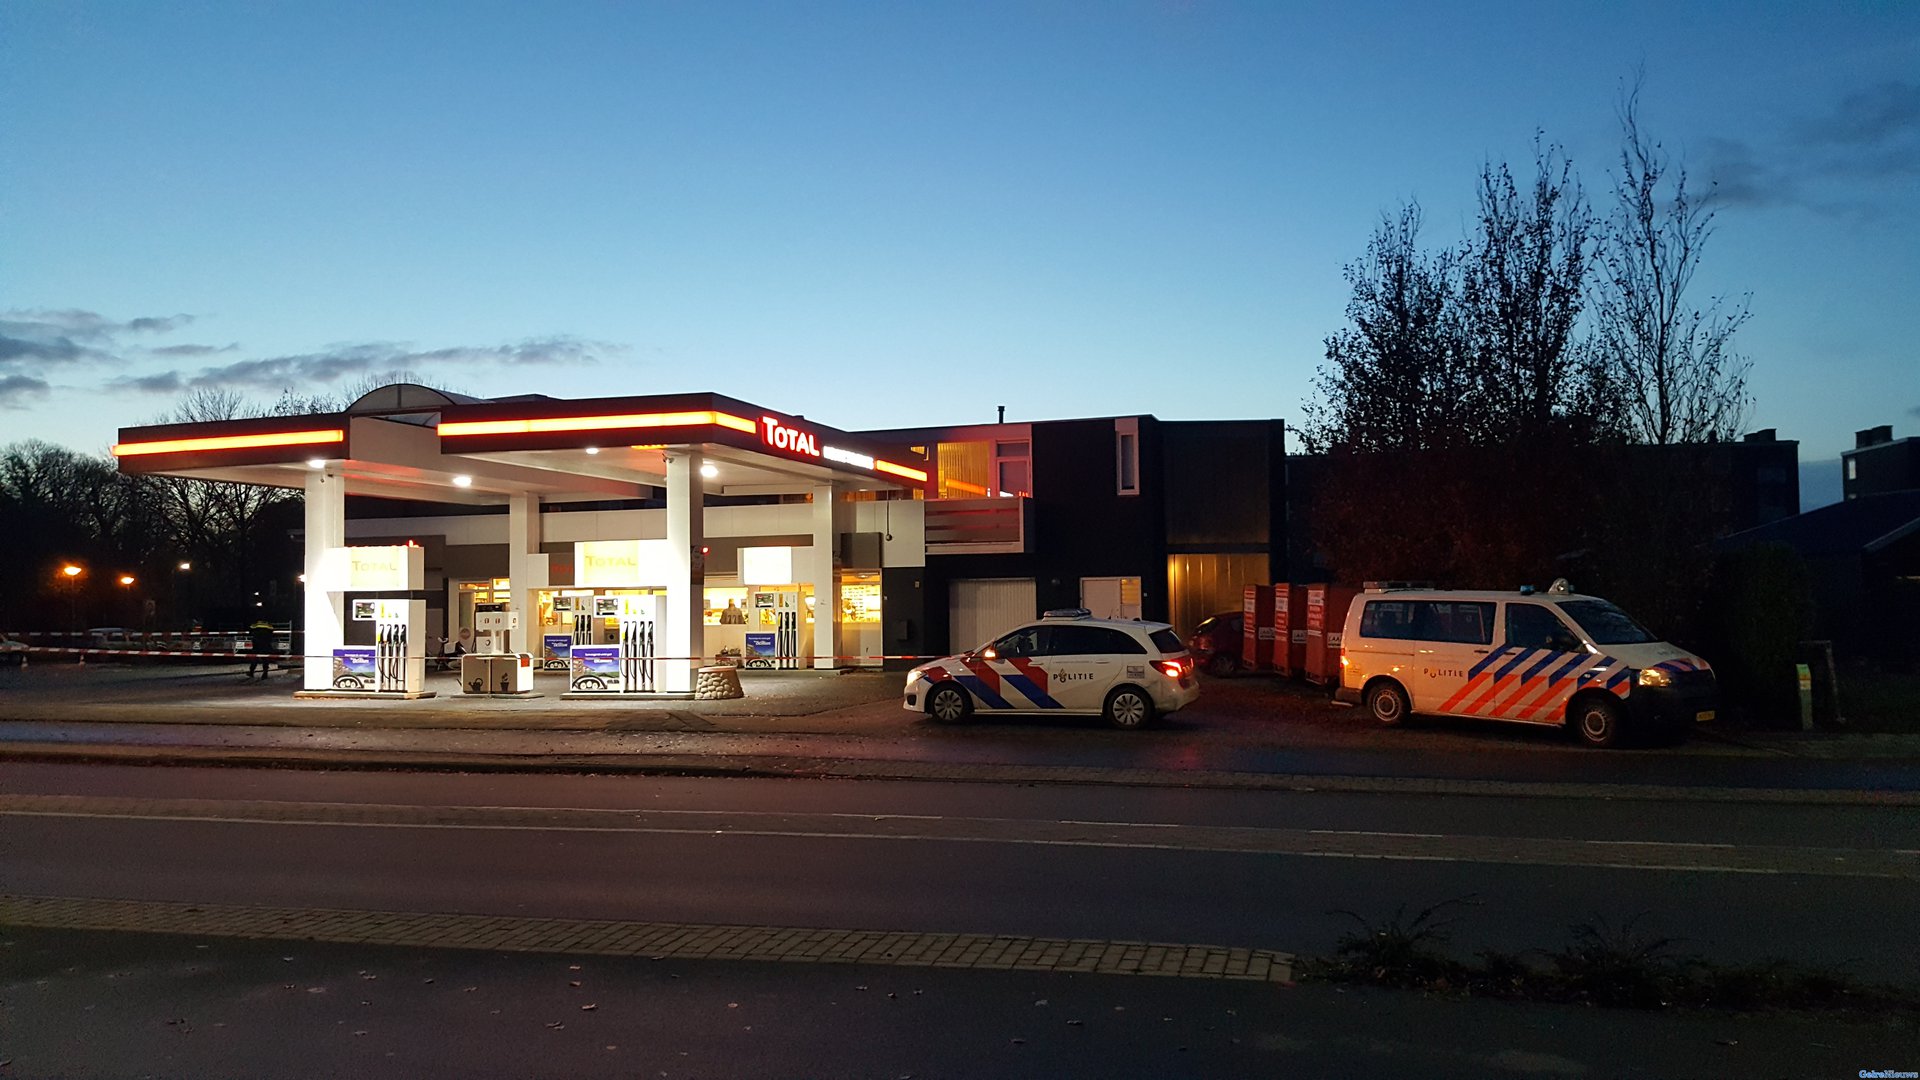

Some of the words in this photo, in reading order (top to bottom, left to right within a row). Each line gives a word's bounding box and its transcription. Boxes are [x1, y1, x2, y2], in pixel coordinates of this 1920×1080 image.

[762, 415, 820, 457] TOTAL
[351, 560, 397, 572] TOTAL
[585, 554, 637, 568] TOTAL
[1053, 671, 1094, 683] POLITIE
[1423, 668, 1464, 679] POLITIE
